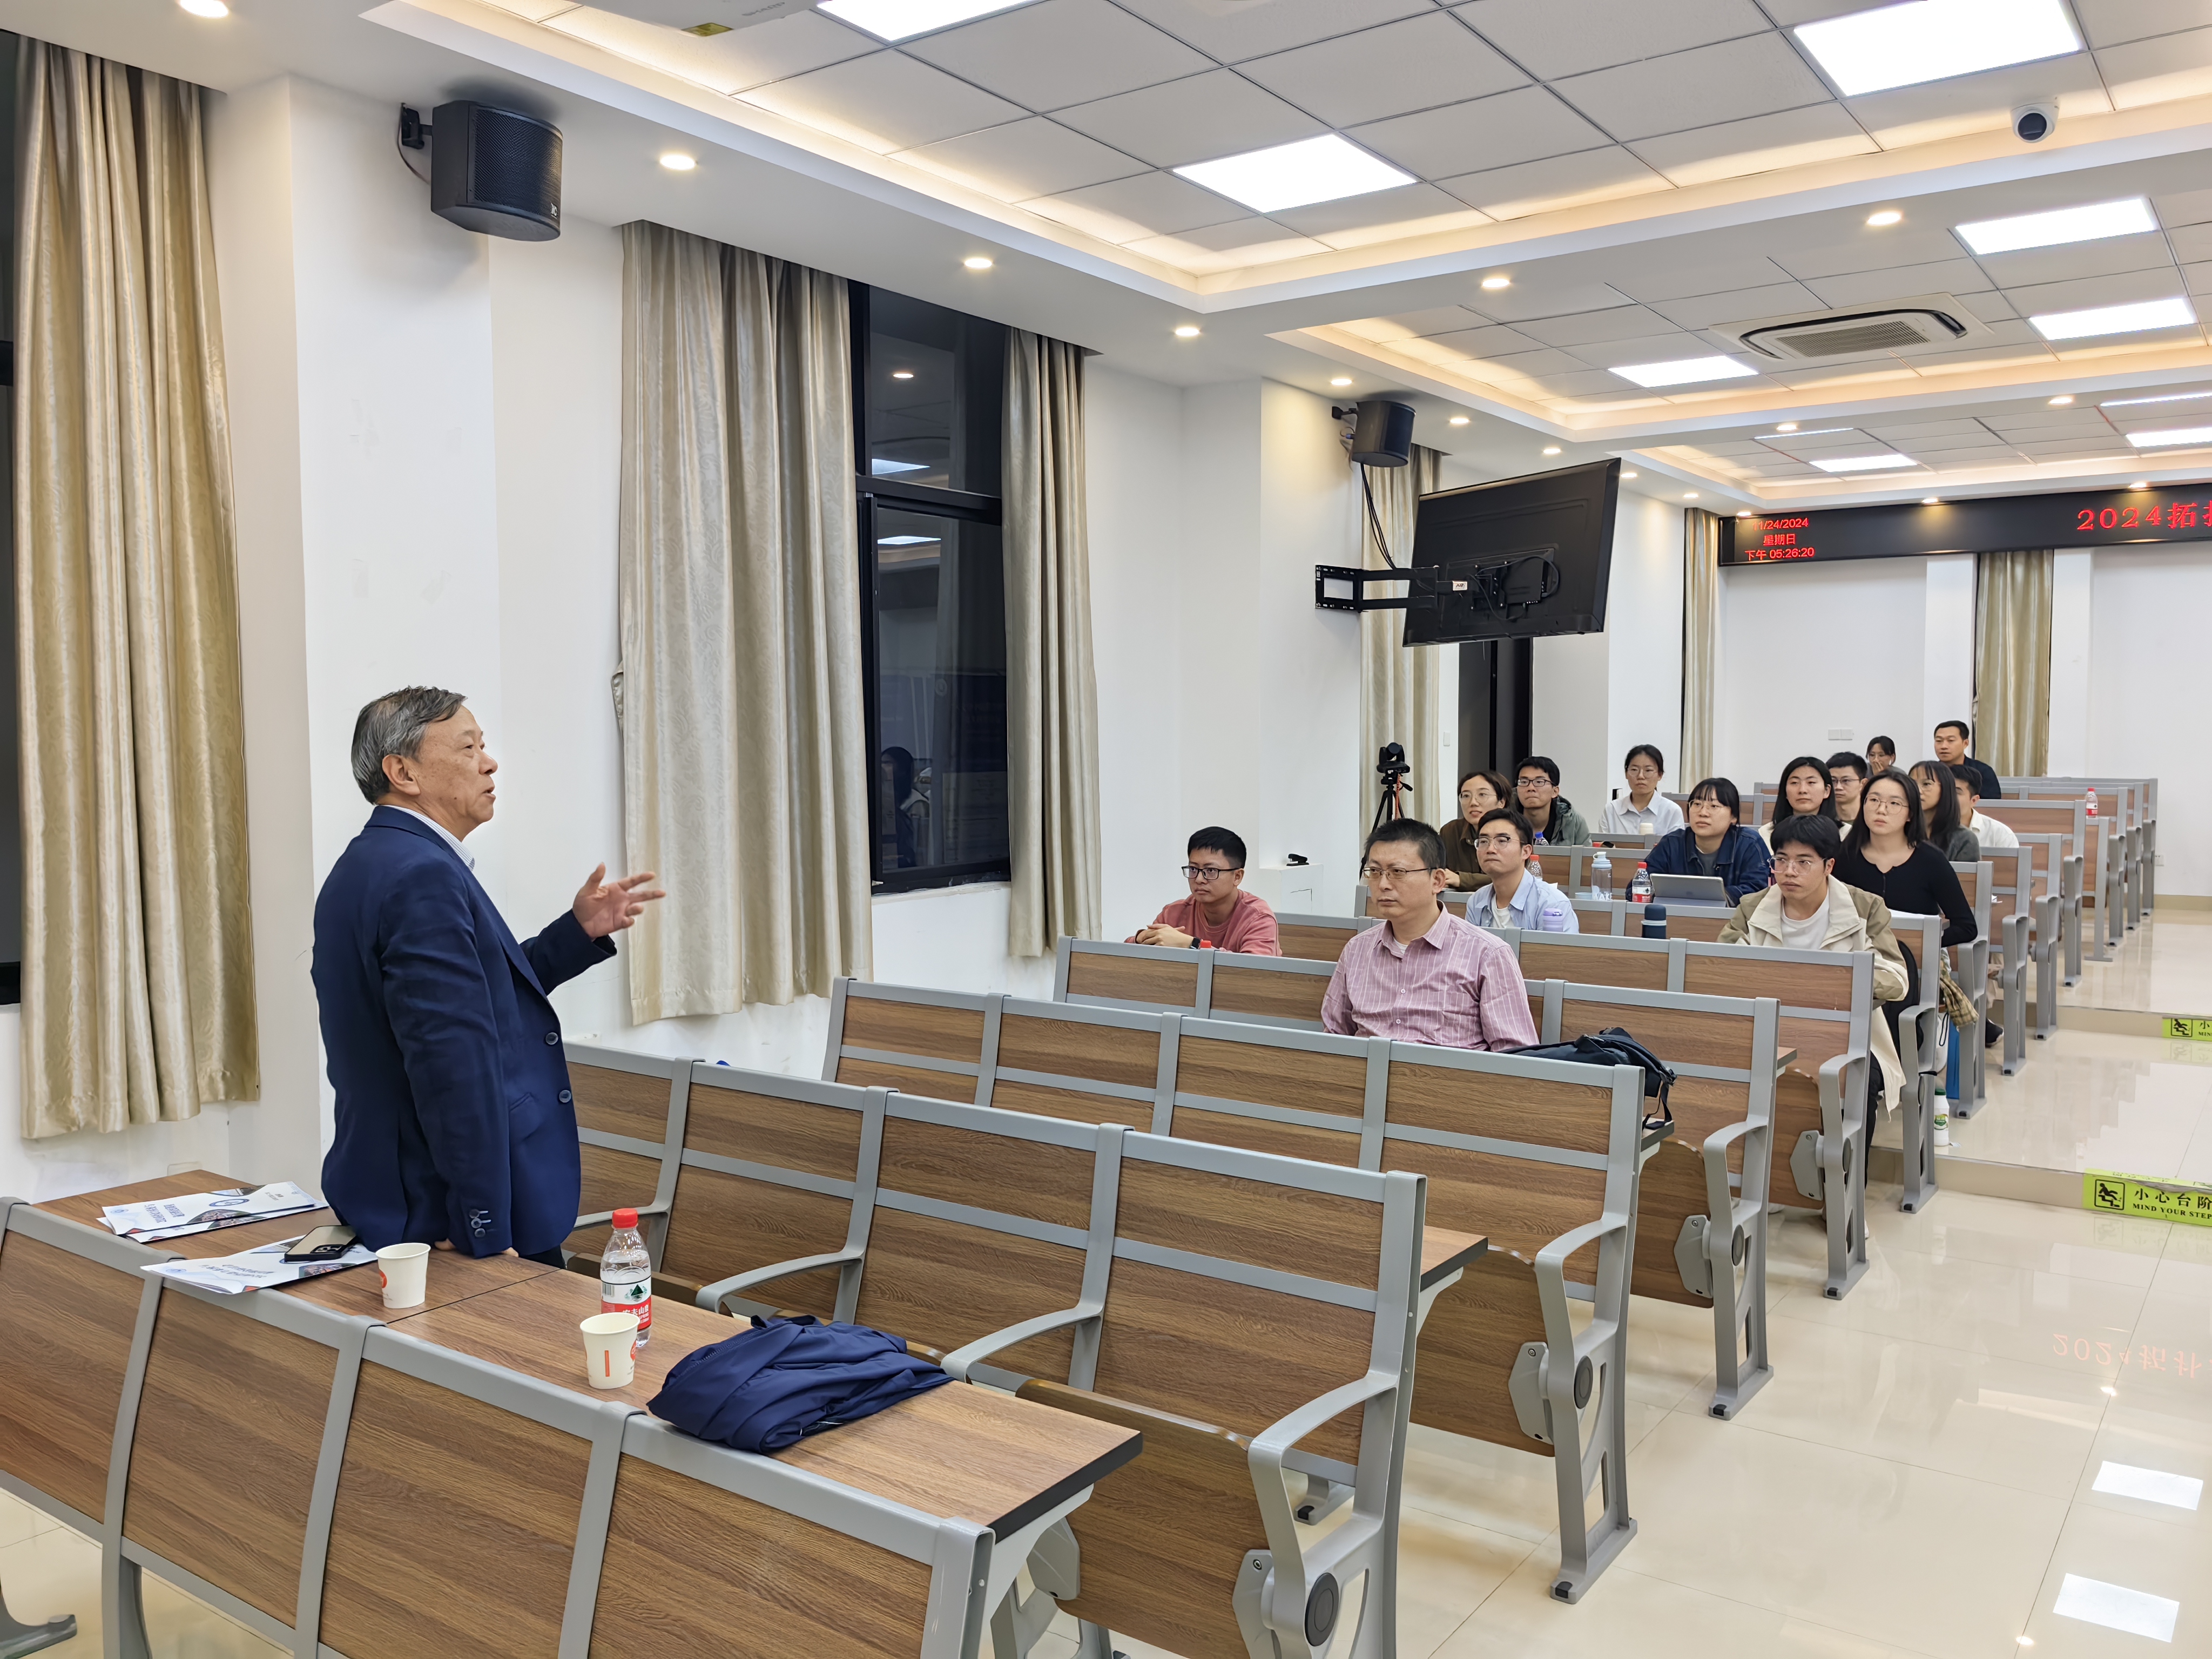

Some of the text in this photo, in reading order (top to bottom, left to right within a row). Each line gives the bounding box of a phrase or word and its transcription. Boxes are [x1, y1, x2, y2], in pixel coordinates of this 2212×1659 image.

[1752, 518, 1809, 530] 11/24/2024
[1763, 534, 1796, 546] 星期日
[1744, 547, 1815, 561] 下午 05:26:20
[2199, 1020, 2210, 1030] 小
[2134, 1188, 2212, 1210] 小心台阶
[2133, 1203, 2212, 1219] MIND YOUR STEP
